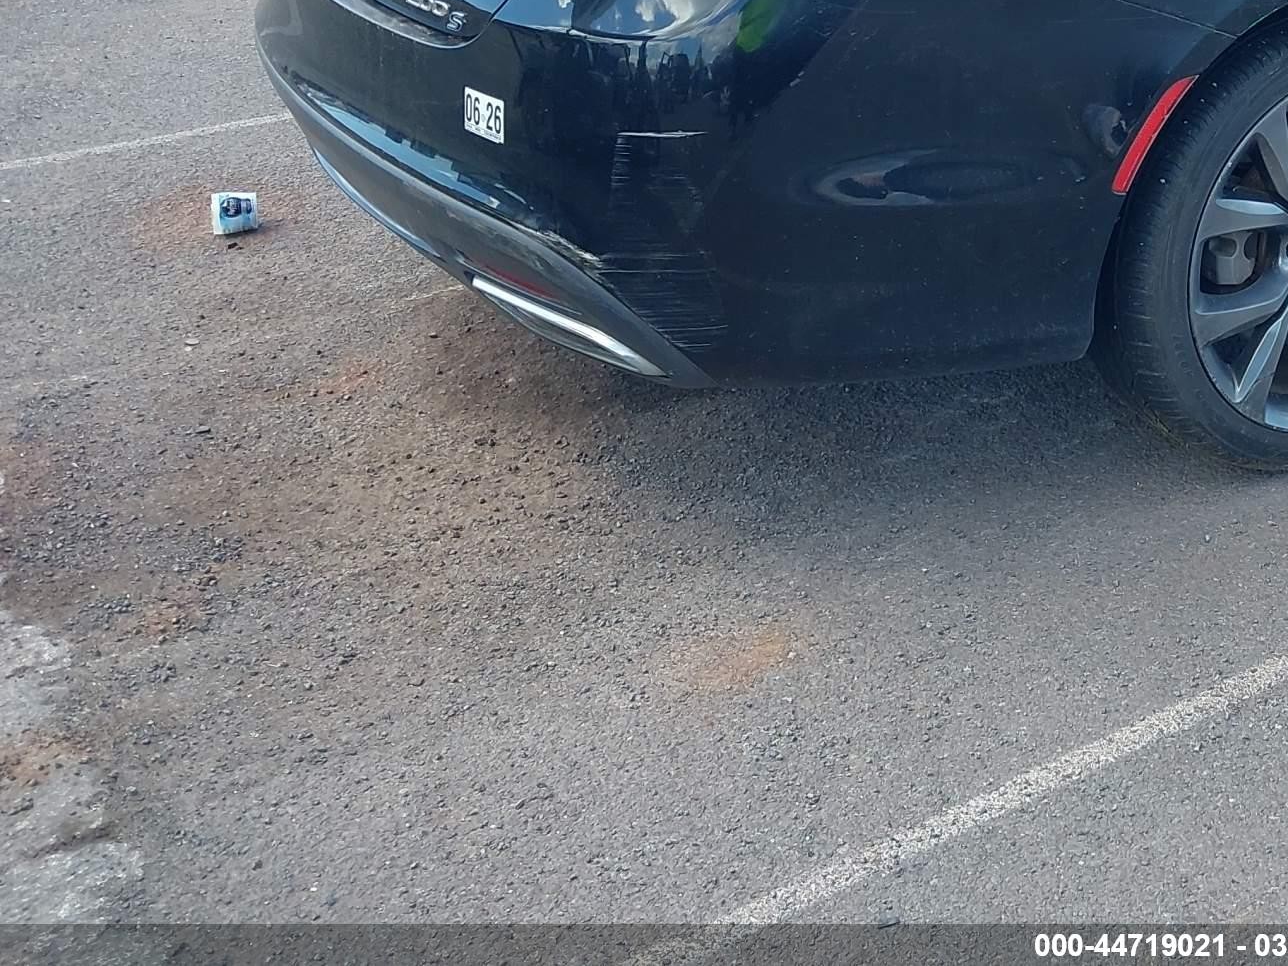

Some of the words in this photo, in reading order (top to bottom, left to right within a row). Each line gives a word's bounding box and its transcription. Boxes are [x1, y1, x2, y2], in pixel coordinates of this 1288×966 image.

[446, 11, 466, 32] S
[465, 93, 481, 126] 06
[486, 101, 502, 134] 26
